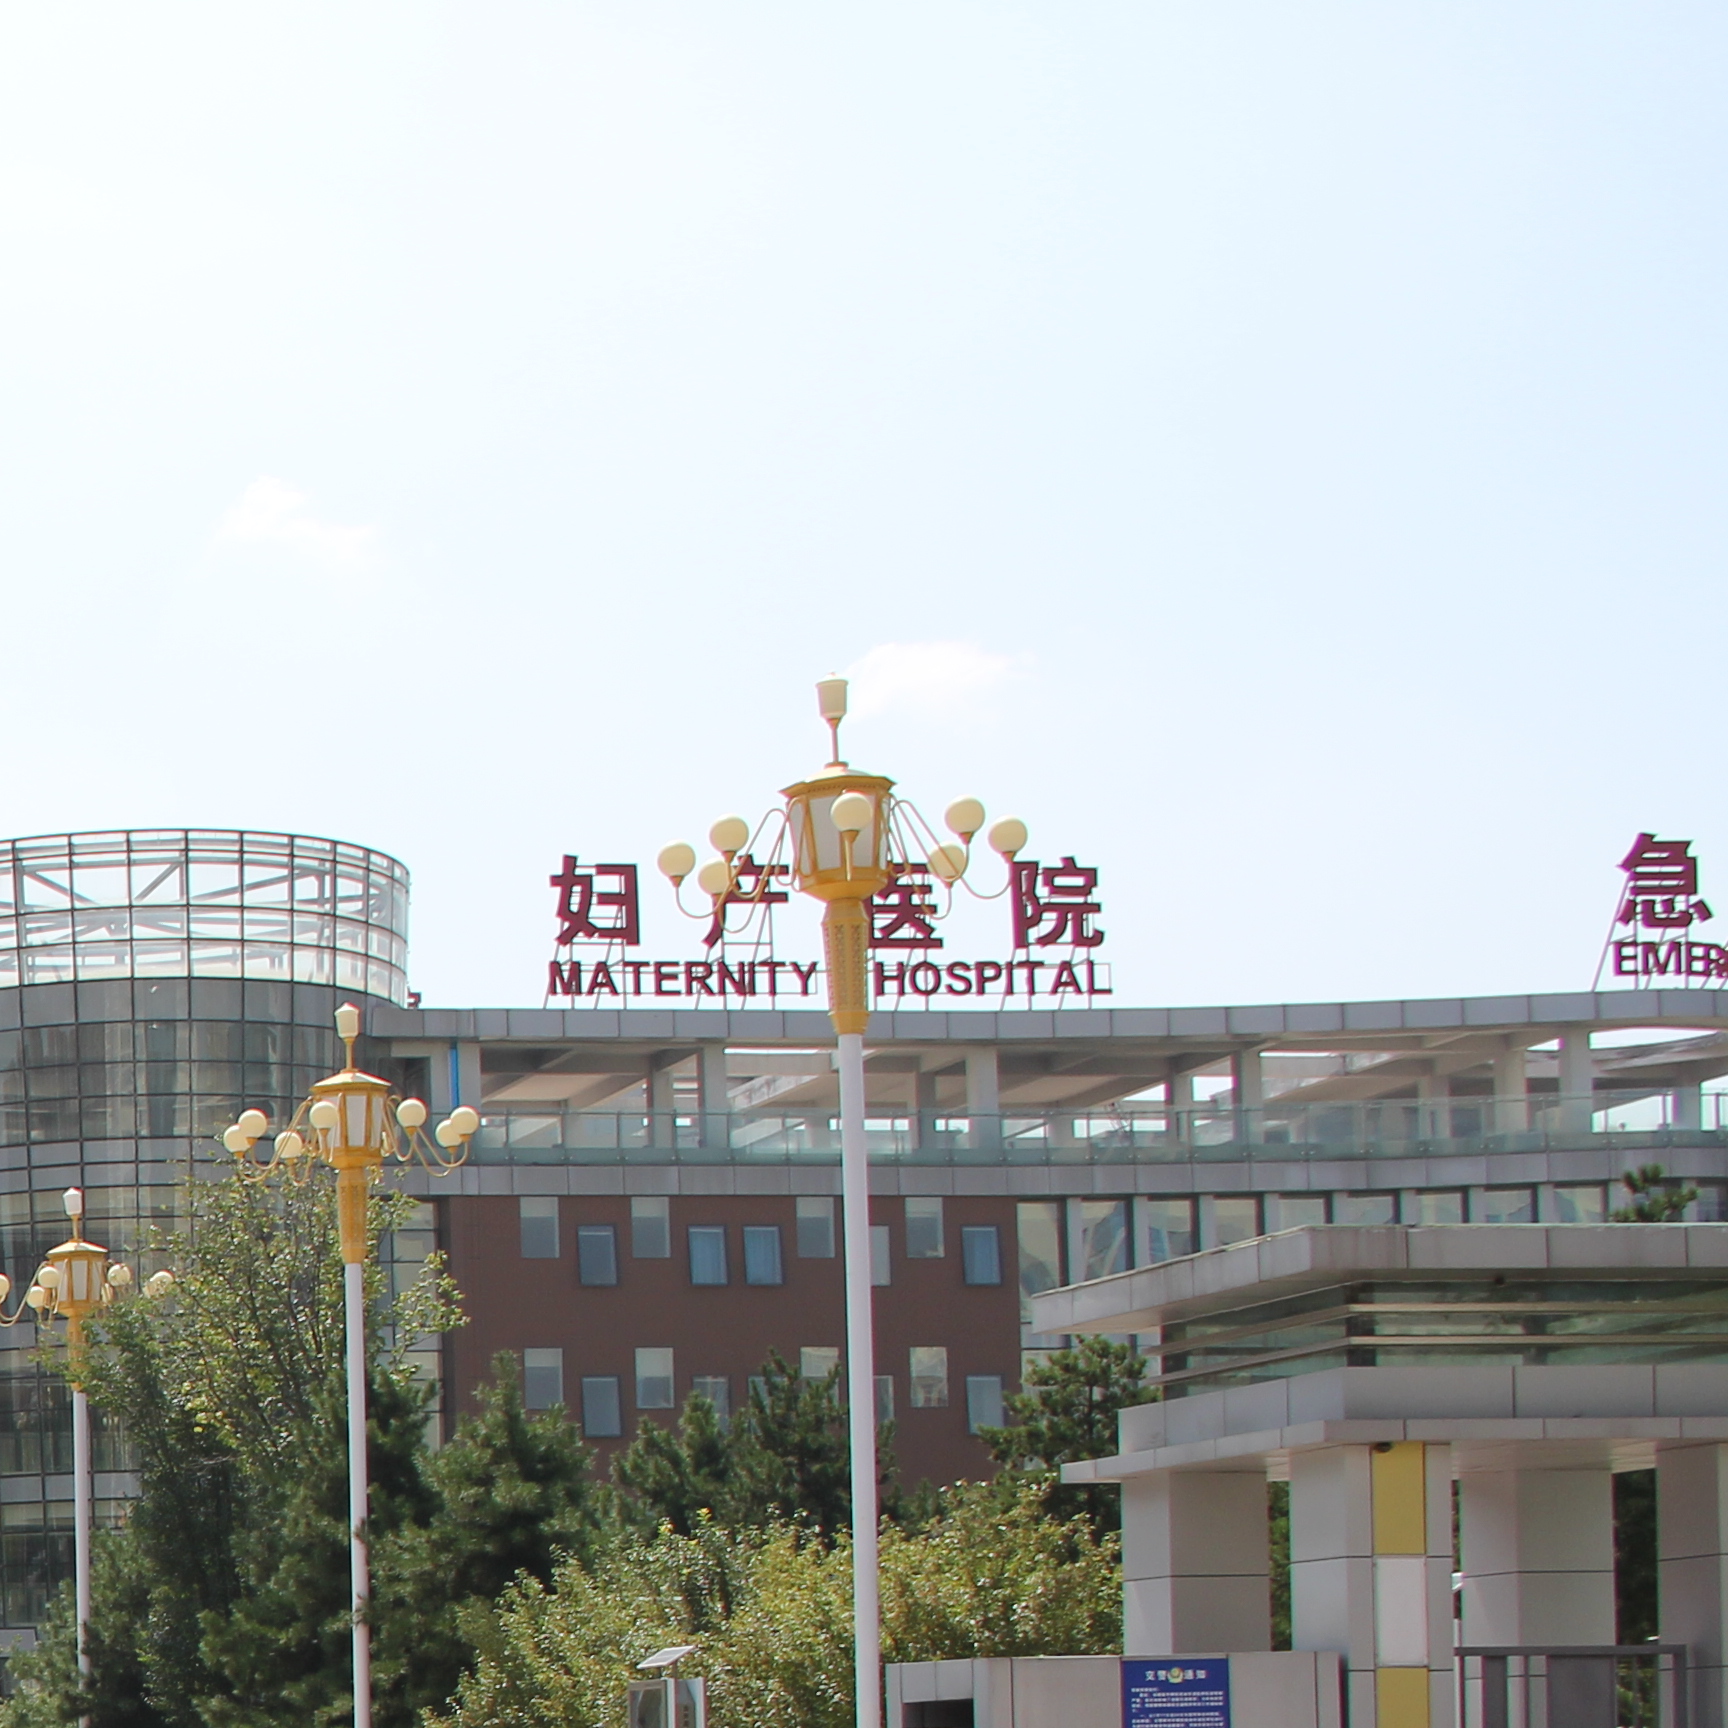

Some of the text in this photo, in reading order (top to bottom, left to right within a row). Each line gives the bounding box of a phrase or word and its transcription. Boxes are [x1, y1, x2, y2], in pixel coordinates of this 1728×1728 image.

[550, 854, 1105, 949] 妇产医院
[548, 959, 1112, 997] MATERNITY HOSPITAL
